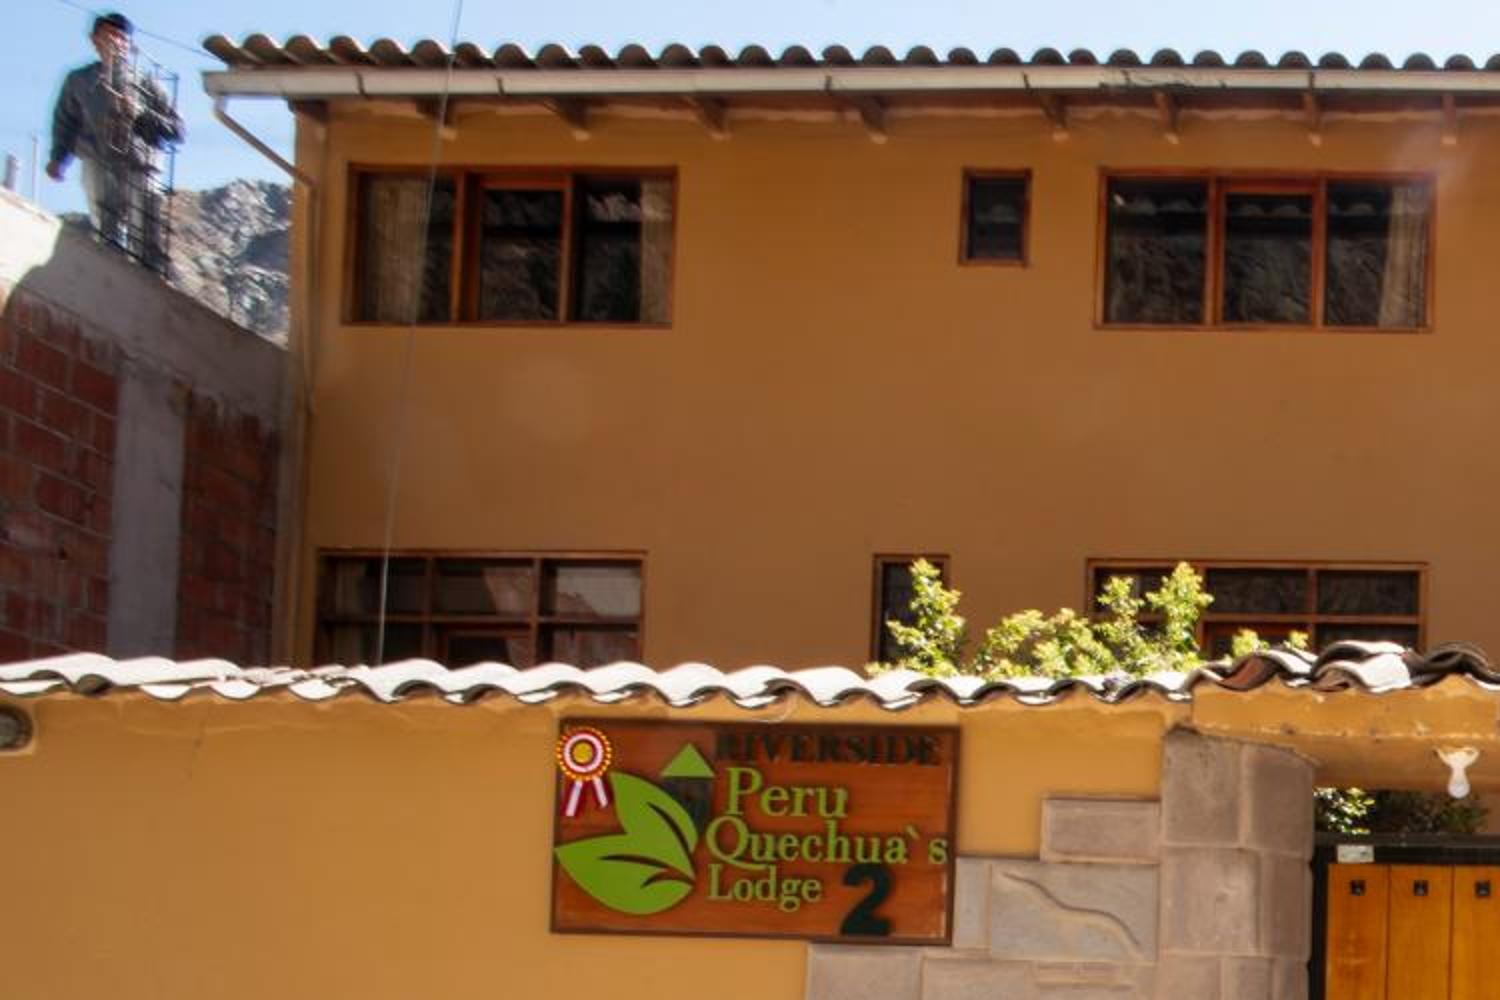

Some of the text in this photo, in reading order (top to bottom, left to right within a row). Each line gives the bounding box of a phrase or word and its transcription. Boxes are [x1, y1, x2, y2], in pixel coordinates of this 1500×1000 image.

[715, 734, 940, 765] RIVERSIDE
[726, 766, 847, 817] Peru
[708, 864, 894, 936] Lodge 2
